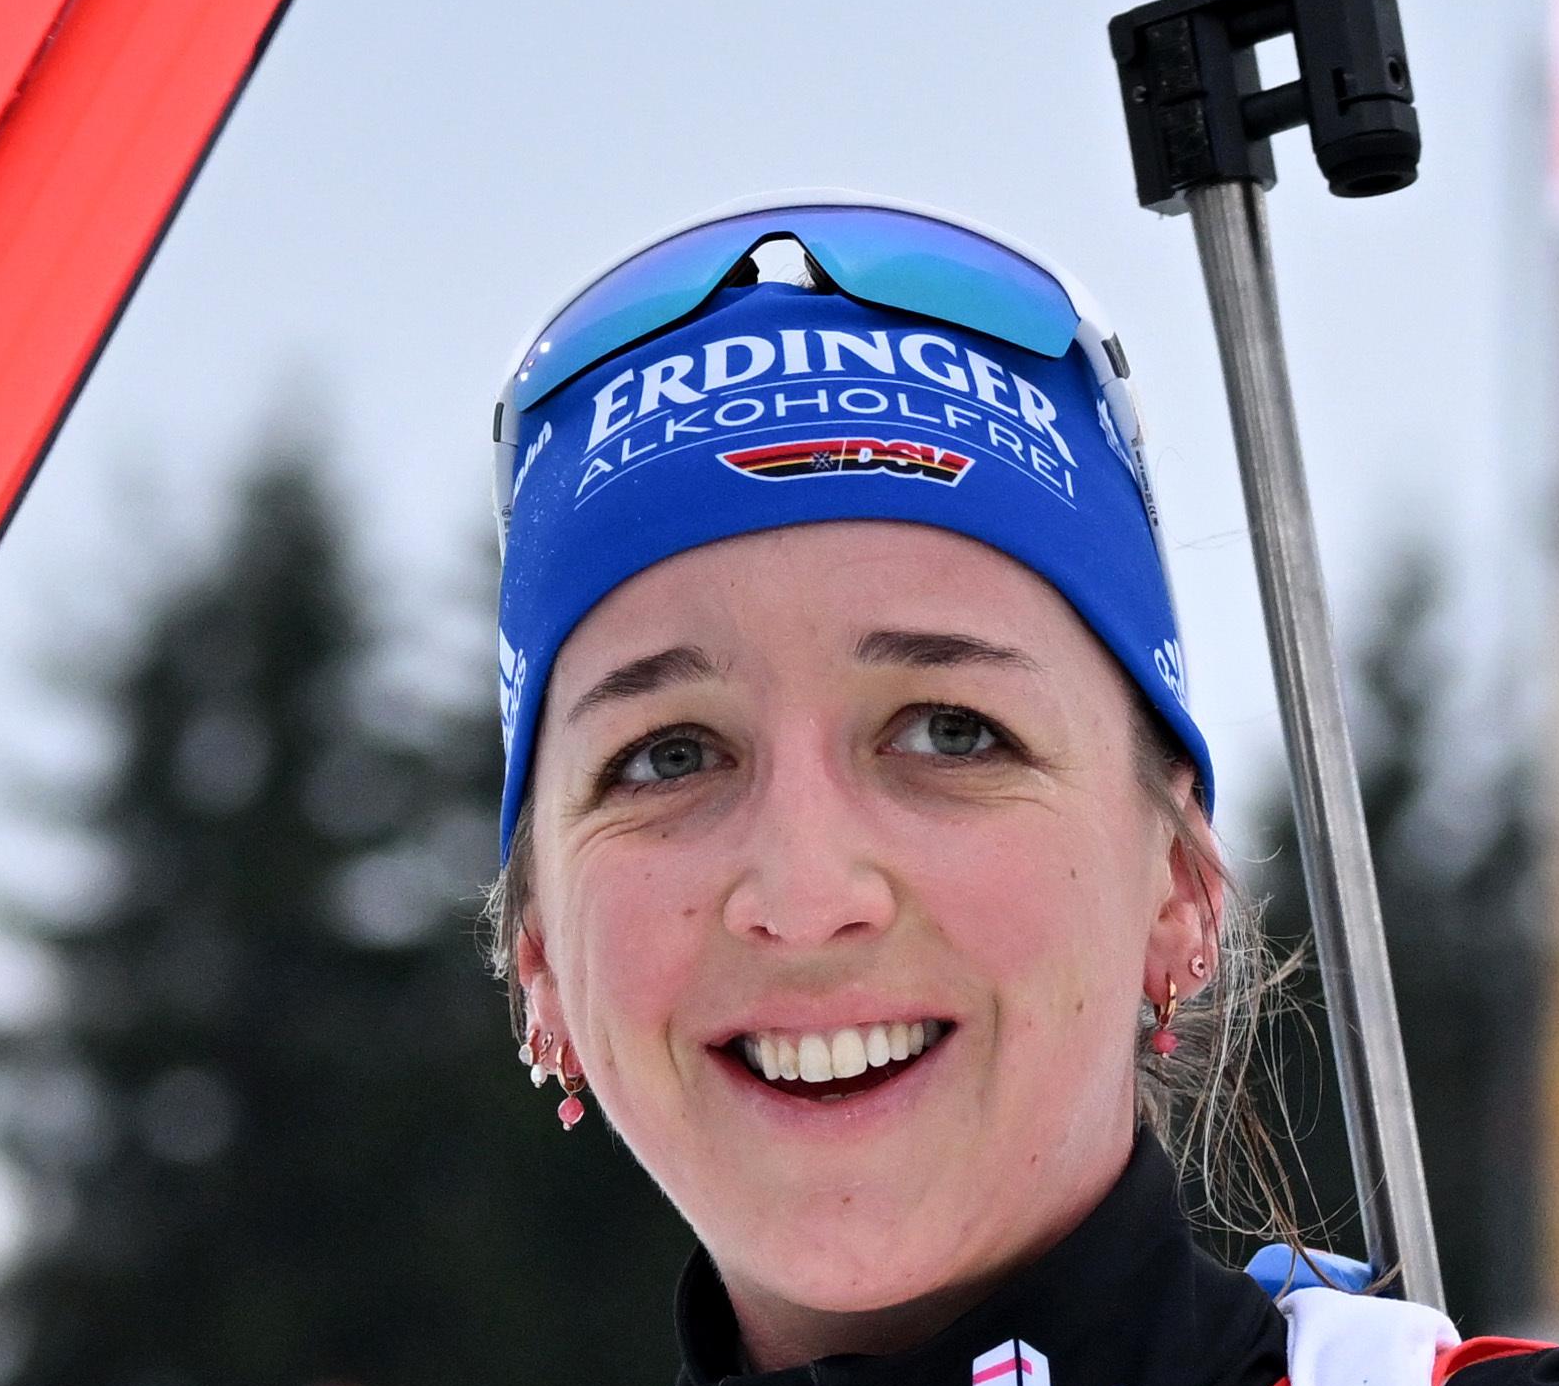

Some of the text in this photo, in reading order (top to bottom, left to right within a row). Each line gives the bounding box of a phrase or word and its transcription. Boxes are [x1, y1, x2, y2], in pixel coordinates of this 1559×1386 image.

[574, 387, 1076, 499] ALKOHOLFREI
[584, 329, 1078, 468] ERDINGER
[843, 438, 975, 487] DSV
